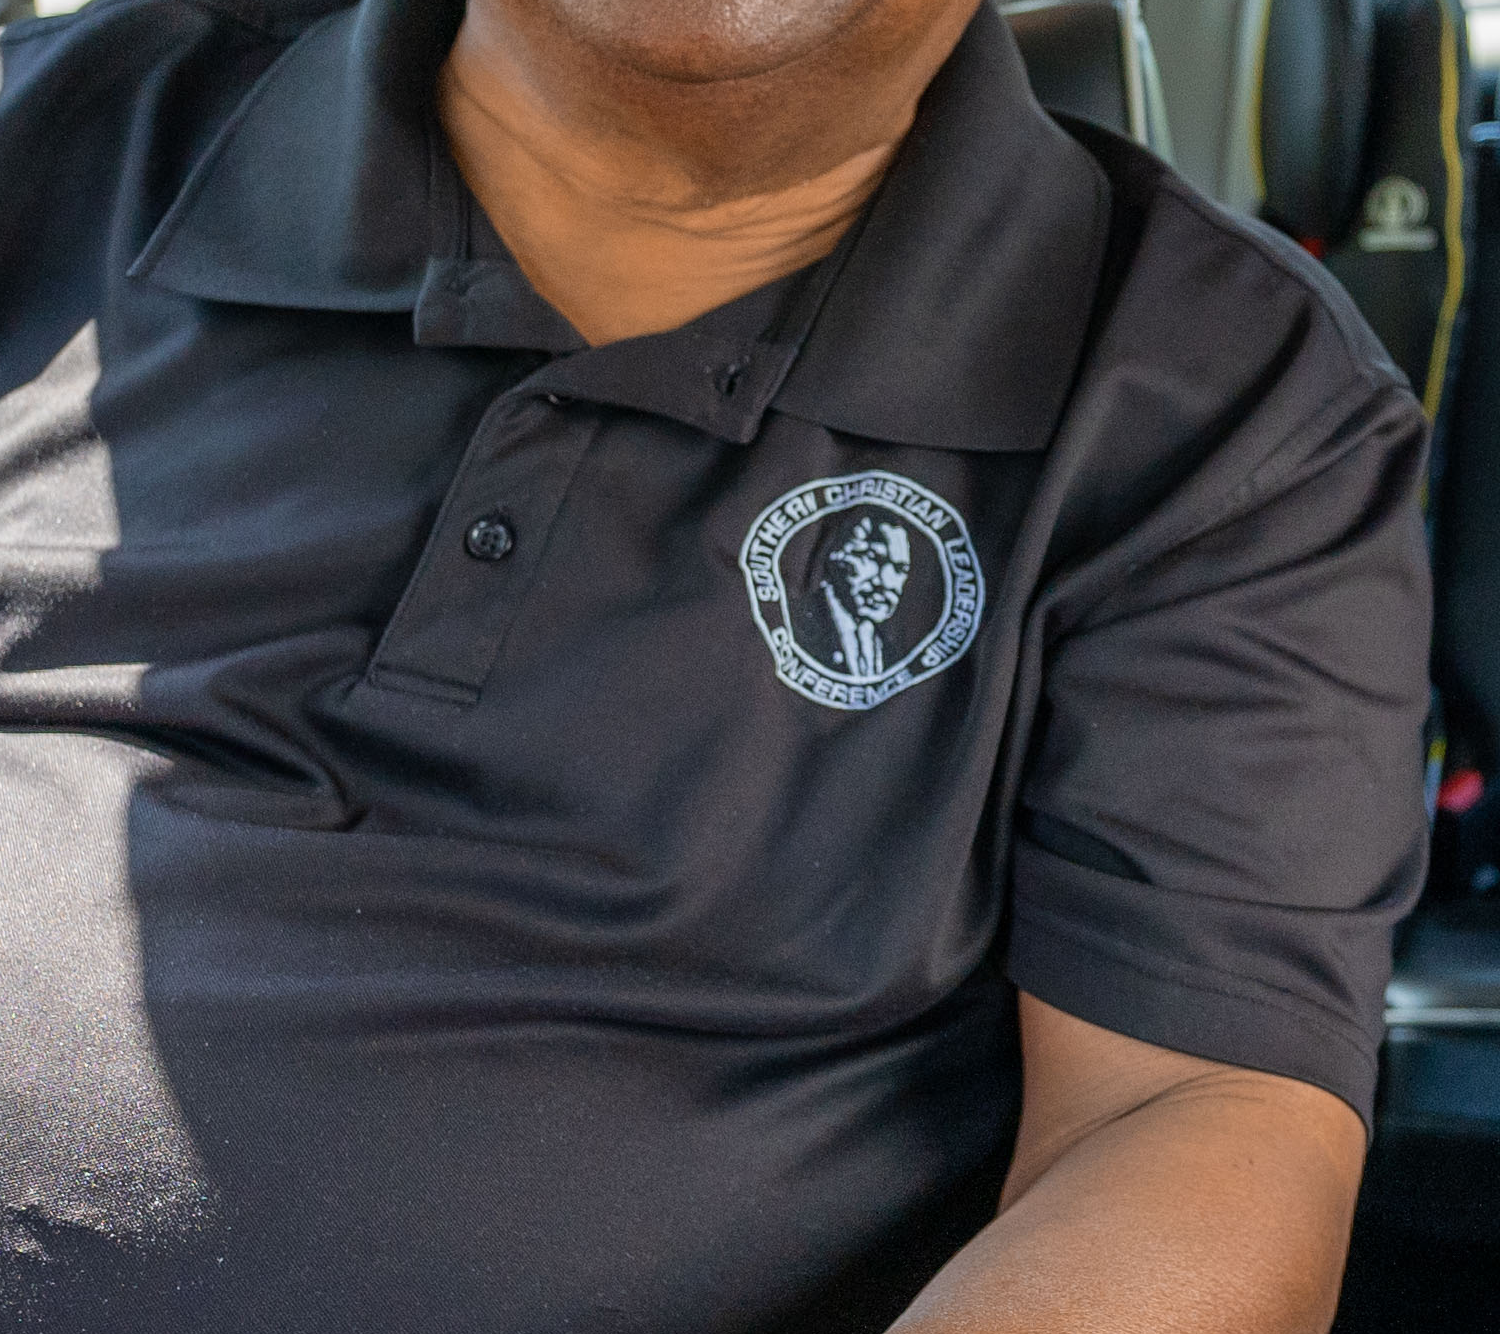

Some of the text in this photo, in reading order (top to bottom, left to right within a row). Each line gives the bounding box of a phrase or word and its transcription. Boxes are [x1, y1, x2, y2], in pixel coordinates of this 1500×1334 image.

[826, 479, 950, 530] CHRISTIAN
[922, 537, 977, 667] LEADERSHIP
[772, 626, 914, 704] CONFERENCE
